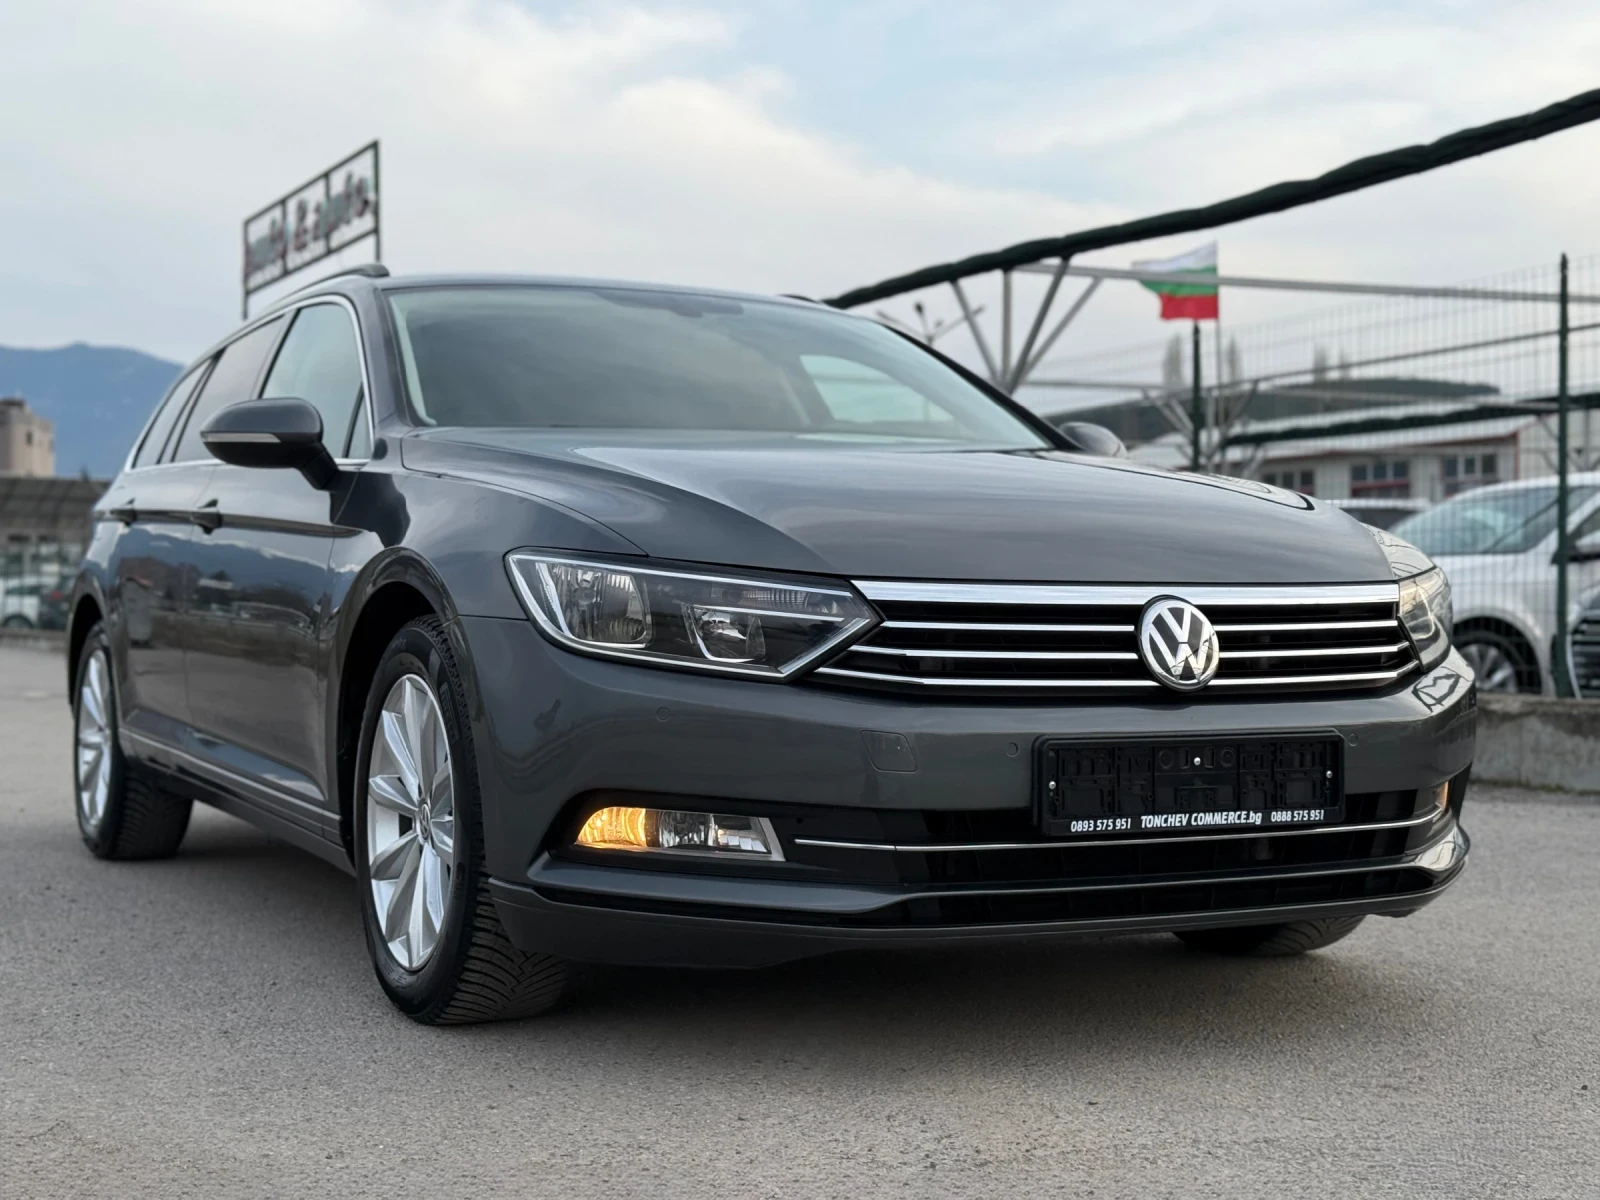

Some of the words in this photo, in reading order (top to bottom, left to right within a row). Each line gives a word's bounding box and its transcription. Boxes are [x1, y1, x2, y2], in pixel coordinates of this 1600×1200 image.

[1142, 599, 1219, 684] VW
[1071, 820, 1094, 832] 0893
[1096, 819, 1114, 831] 575
[1115, 818, 1132, 830] 951
[1141, 813, 1189, 828] TONCHEV
[1191, 811, 1262, 825] COMMERCE.bg
[1271, 811, 1292, 822] 0888
[1293, 810, 1309, 821] 575
[1310, 809, 1325, 820] 951
